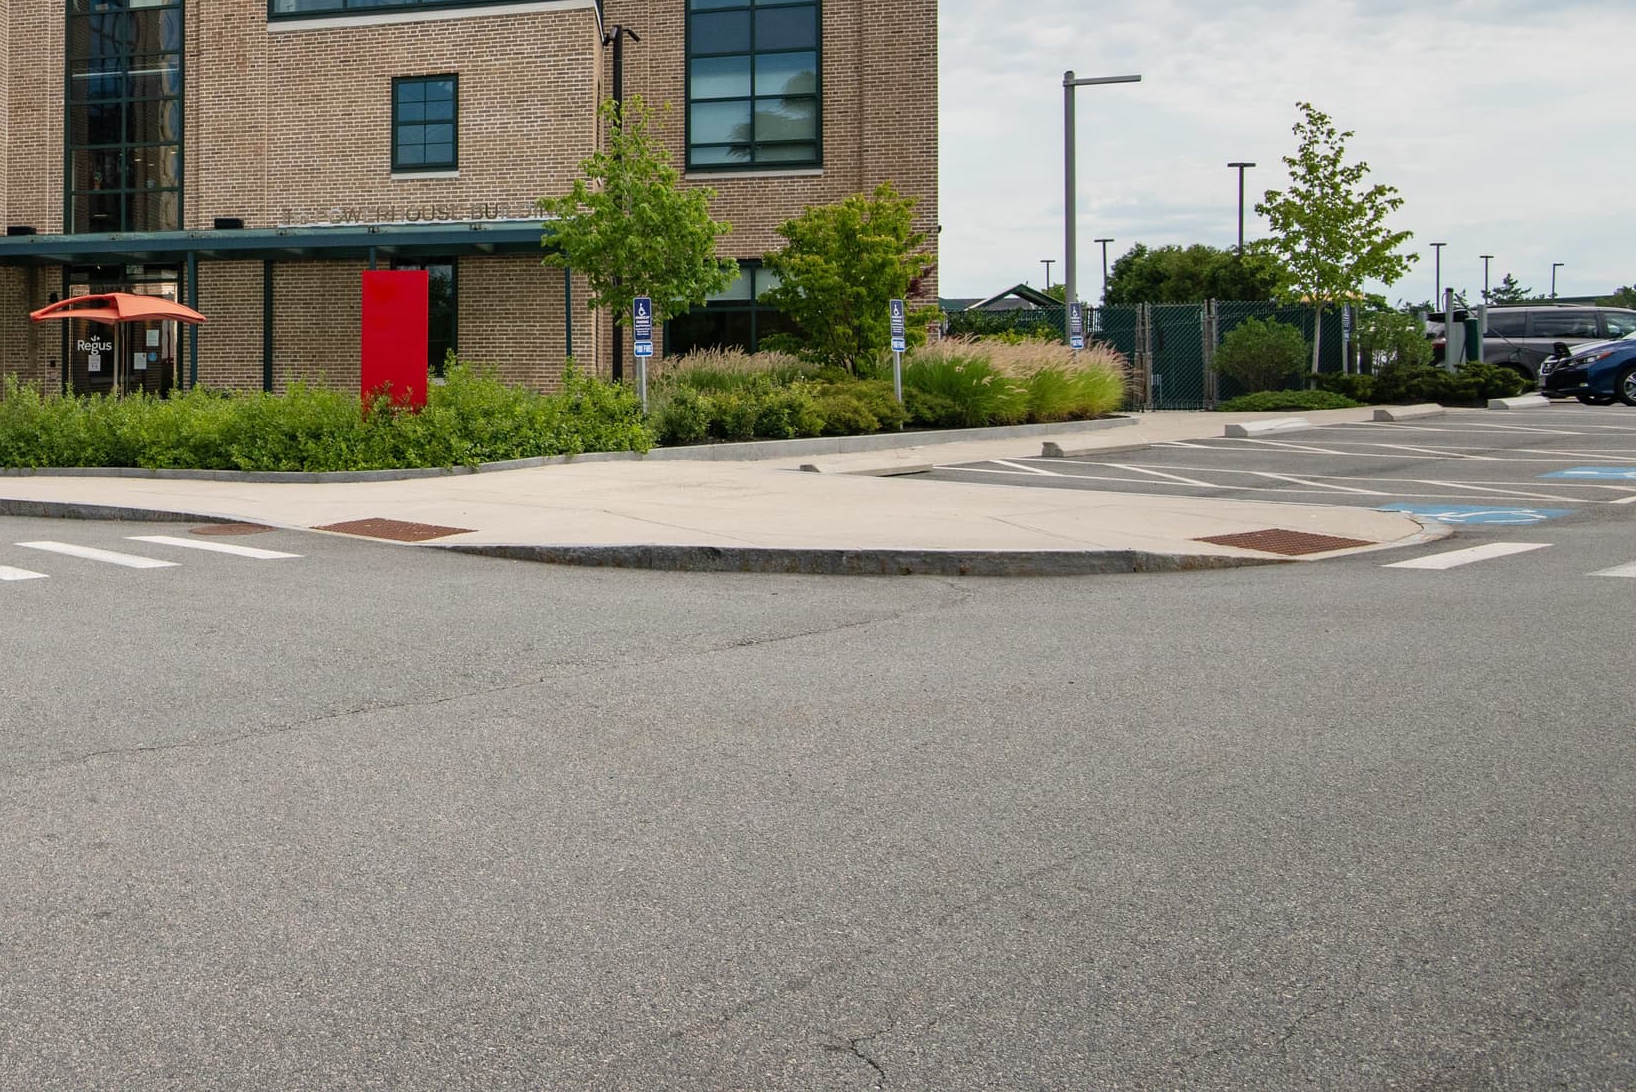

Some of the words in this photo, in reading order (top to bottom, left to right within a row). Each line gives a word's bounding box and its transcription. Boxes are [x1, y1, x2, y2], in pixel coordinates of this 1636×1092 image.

[317, 205, 456, 225] POWERHOUSE
[470, 203, 555, 221] BUILDIN
[77, 339, 112, 356] Regus
